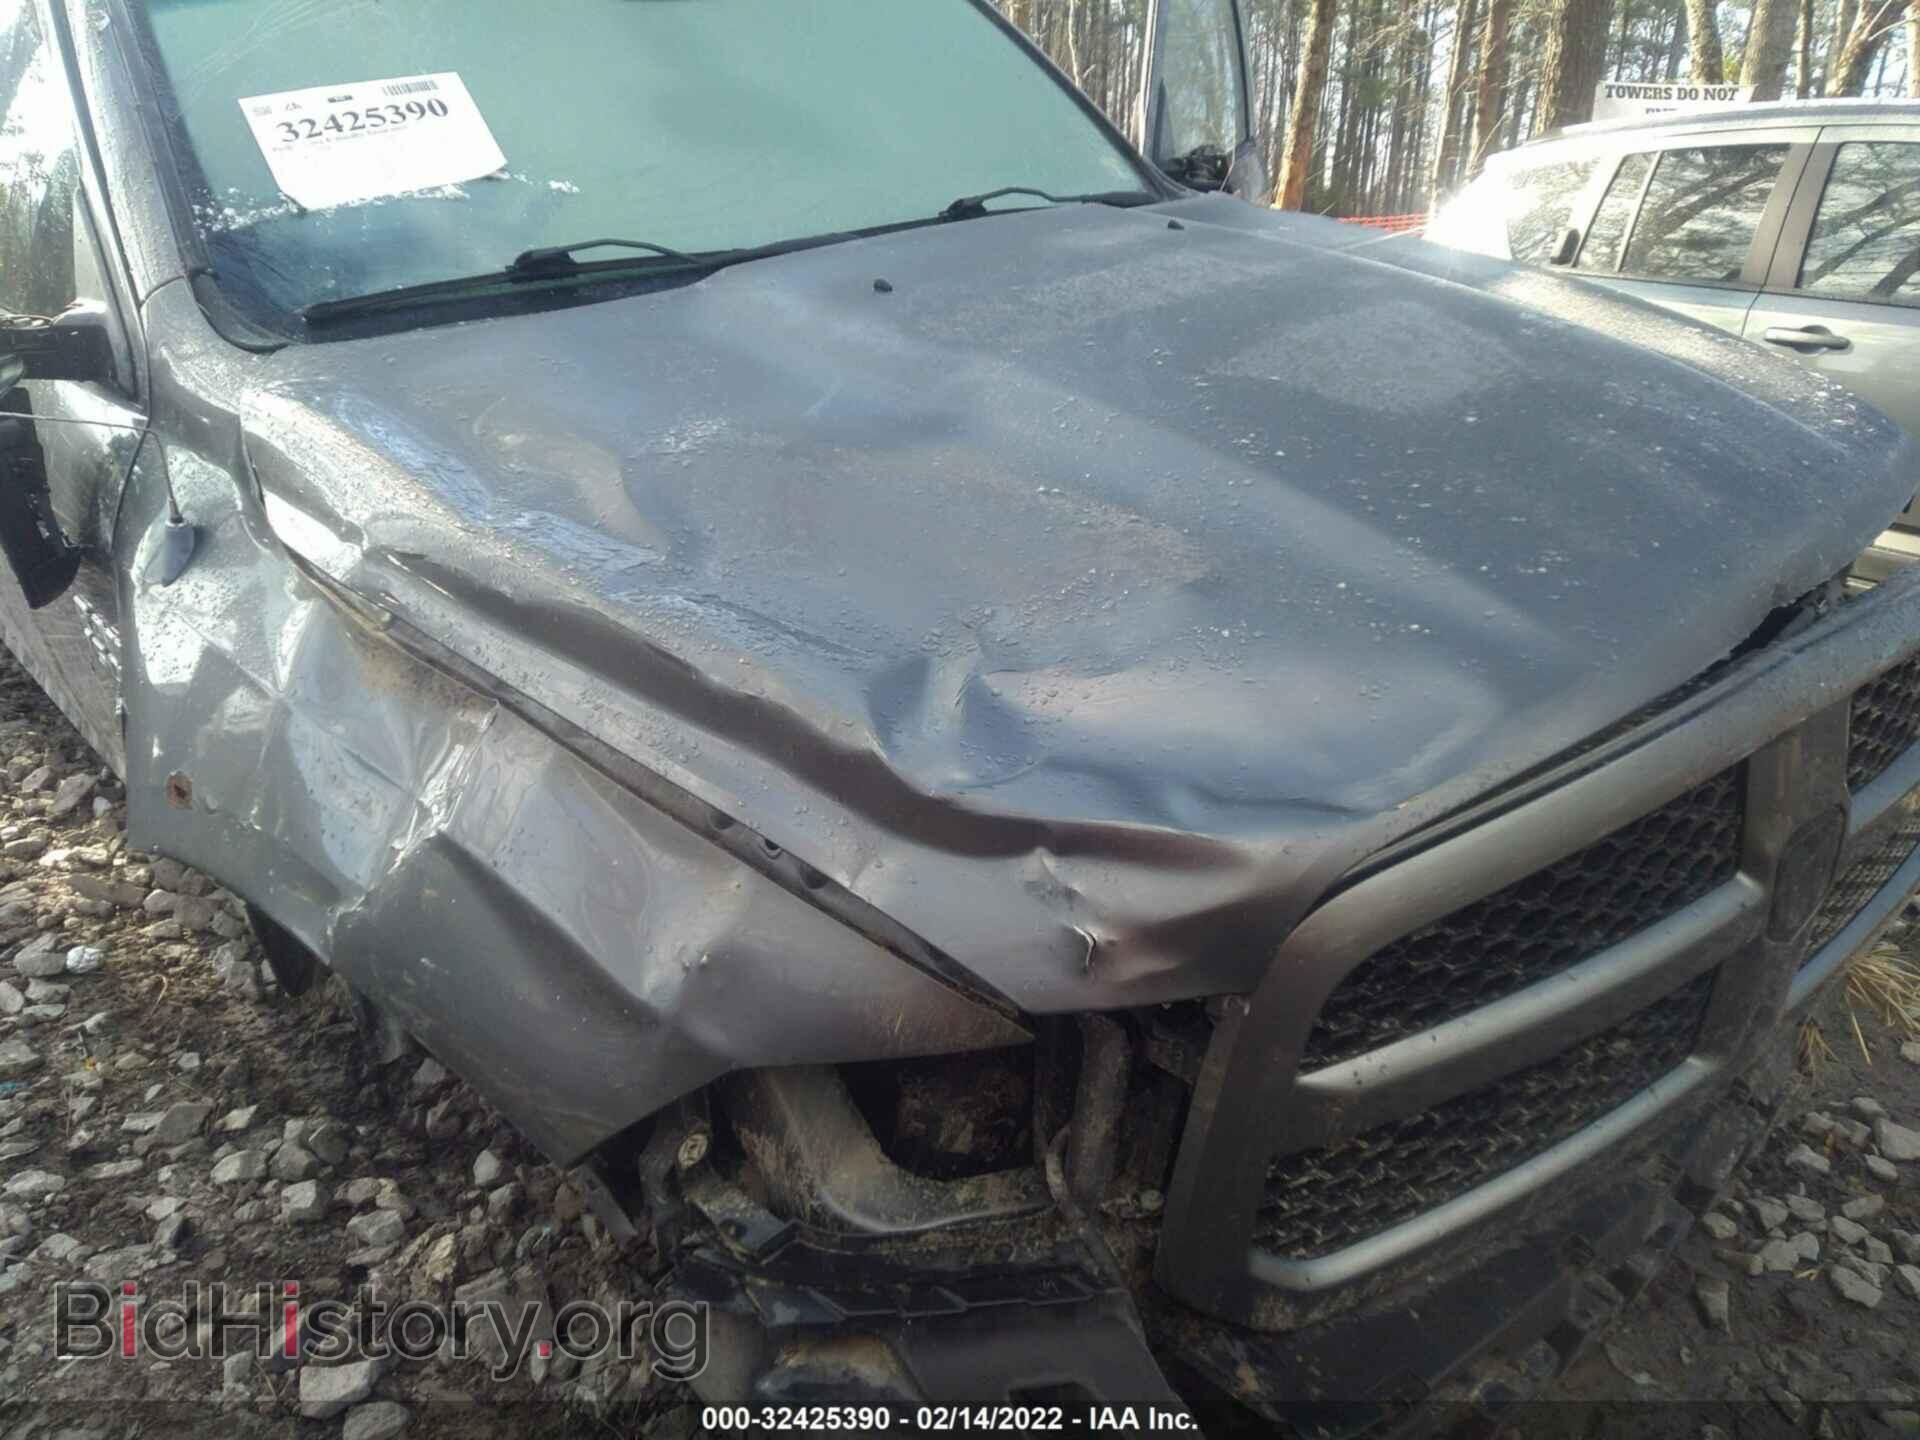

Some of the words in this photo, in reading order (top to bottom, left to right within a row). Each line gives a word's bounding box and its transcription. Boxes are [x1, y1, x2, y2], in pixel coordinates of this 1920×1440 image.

[1605, 85, 1673, 101] TOWERS
[1677, 86, 1698, 101] DO
[1703, 87, 1739, 101] NOT
[276, 97, 449, 143] 32425390
